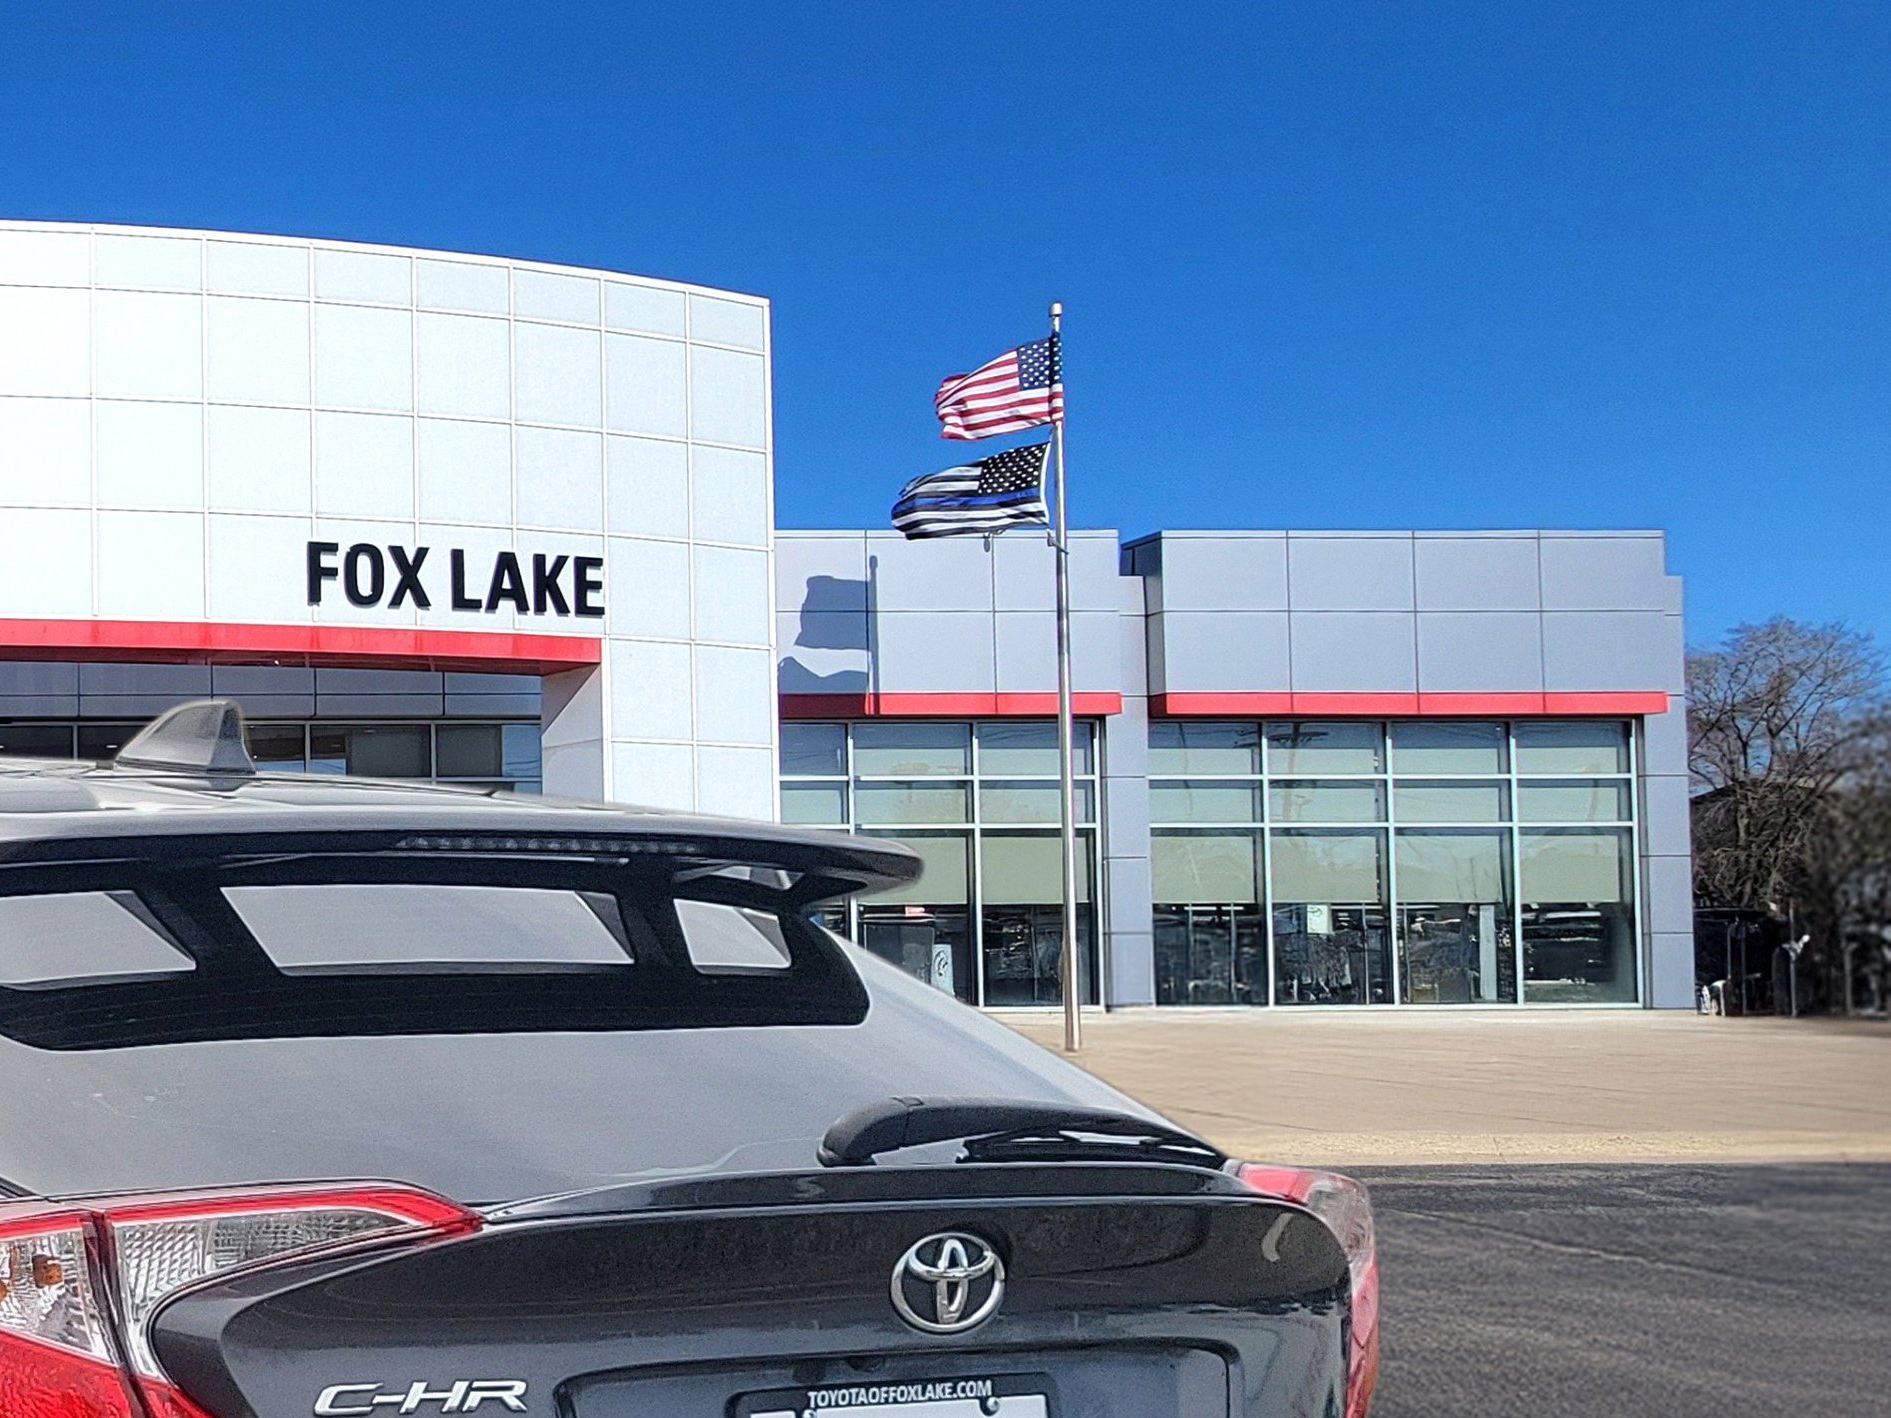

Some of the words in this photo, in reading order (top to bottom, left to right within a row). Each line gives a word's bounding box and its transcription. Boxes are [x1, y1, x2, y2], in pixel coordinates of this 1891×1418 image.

[307, 541, 431, 610] FOX
[450, 549, 605, 616] LAKE
[314, 1380, 527, 1416] C-HR
[807, 1380, 992, 1408] TOYOTAOFFOXLAKE.COM
